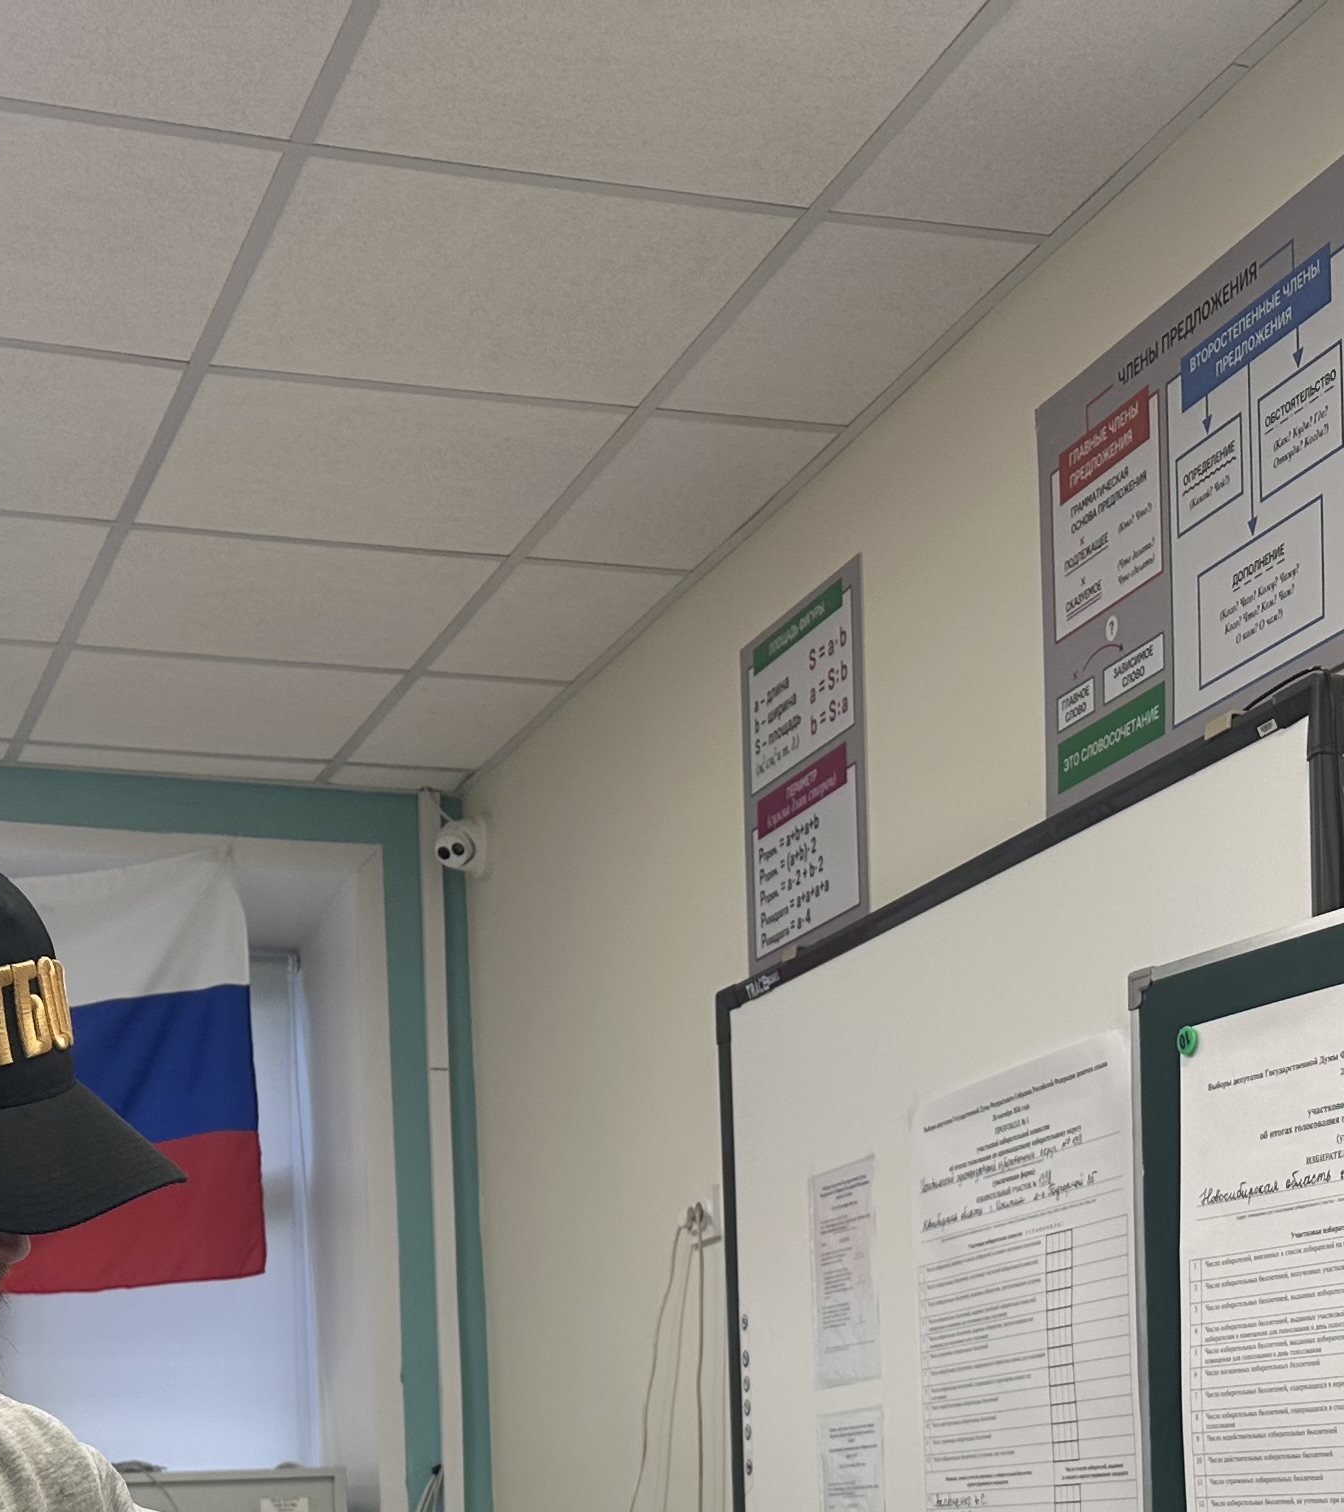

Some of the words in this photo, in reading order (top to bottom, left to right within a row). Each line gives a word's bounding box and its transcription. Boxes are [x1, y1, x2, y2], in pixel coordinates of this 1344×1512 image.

[1118, 343, 1159, 385] ЧЛЕНЫ
[1161, 261, 1258, 354] ПРЕДЛОЖЕНИЯ
[1189, 289, 1281, 373] ВТОРОСТЕПЕННЫЕ
[1282, 259, 1321, 302] ЧЛЕНЫ
[1215, 306, 1293, 377] ПРЕДЛОЖЕНИЯ
[1265, 369, 1336, 427] ОБСТОЯТЕЛЬСТВО
[1068, 426, 1107, 467] ГЛАВНЫЕ
[1108, 402, 1139, 432] ЧЛЕНЫ
[1070, 429, 1133, 488] ПРЕДЛОЖЕНИЯ
[1183, 440, 1235, 486] ОПРЕДЕЛЕНИЕ
[1232, 543, 1284, 588] ДОПОЛНЕНИЕ
[1064, 752, 1079, 772] ЭТО
[1081, 705, 1159, 762] СЛОВОСОЧЕТАНИЕ
[1199, 1180, 1279, 1206] Новосибирская
[1285, 1171, 1331, 1190] область
